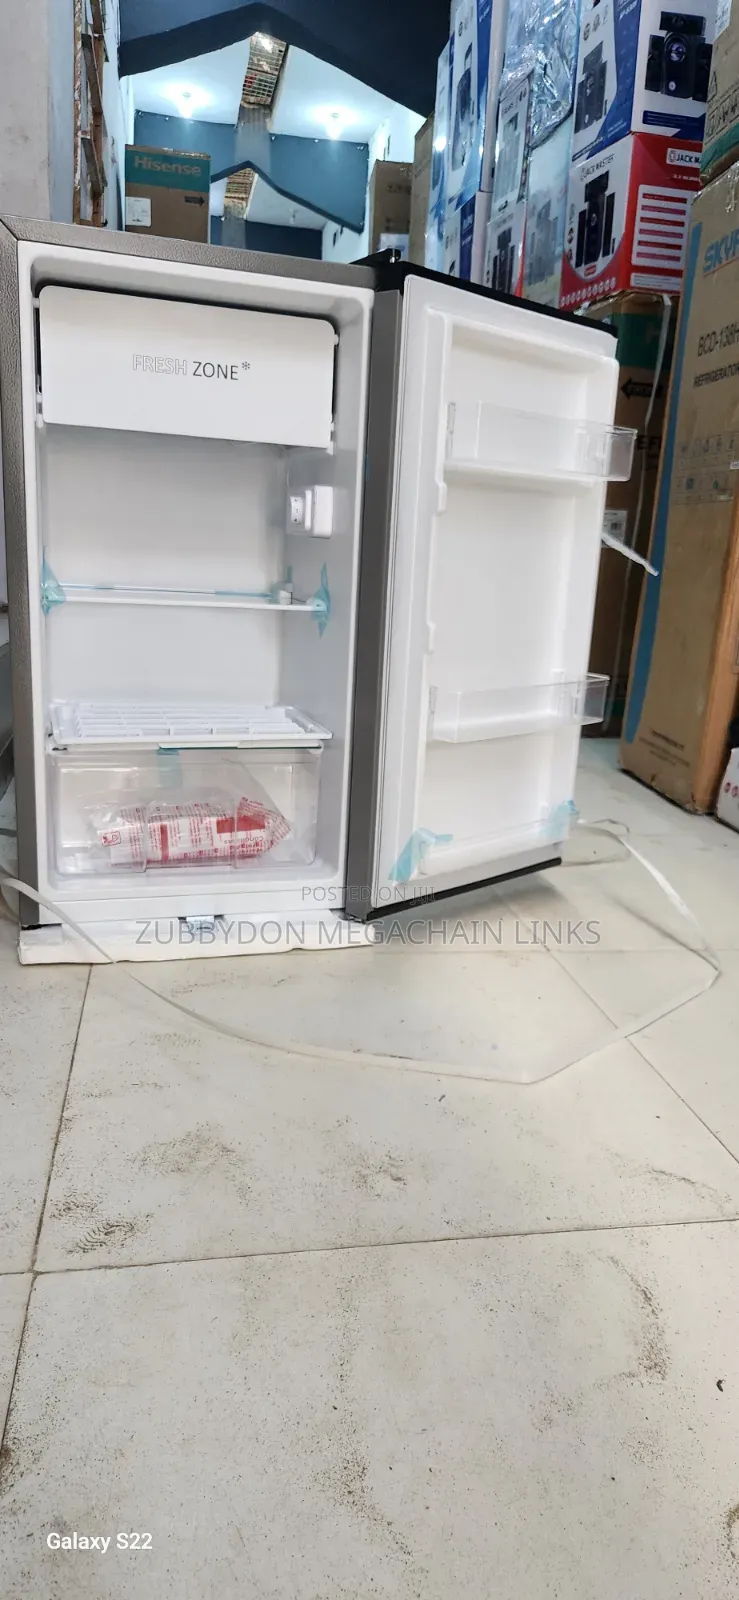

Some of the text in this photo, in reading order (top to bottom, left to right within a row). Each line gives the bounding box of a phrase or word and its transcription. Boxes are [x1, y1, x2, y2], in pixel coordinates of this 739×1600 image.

[134, 155, 201, 176] Hisense
[676, 153, 693, 163] JACK
[132, 354, 239, 381] FRESH ZONE
